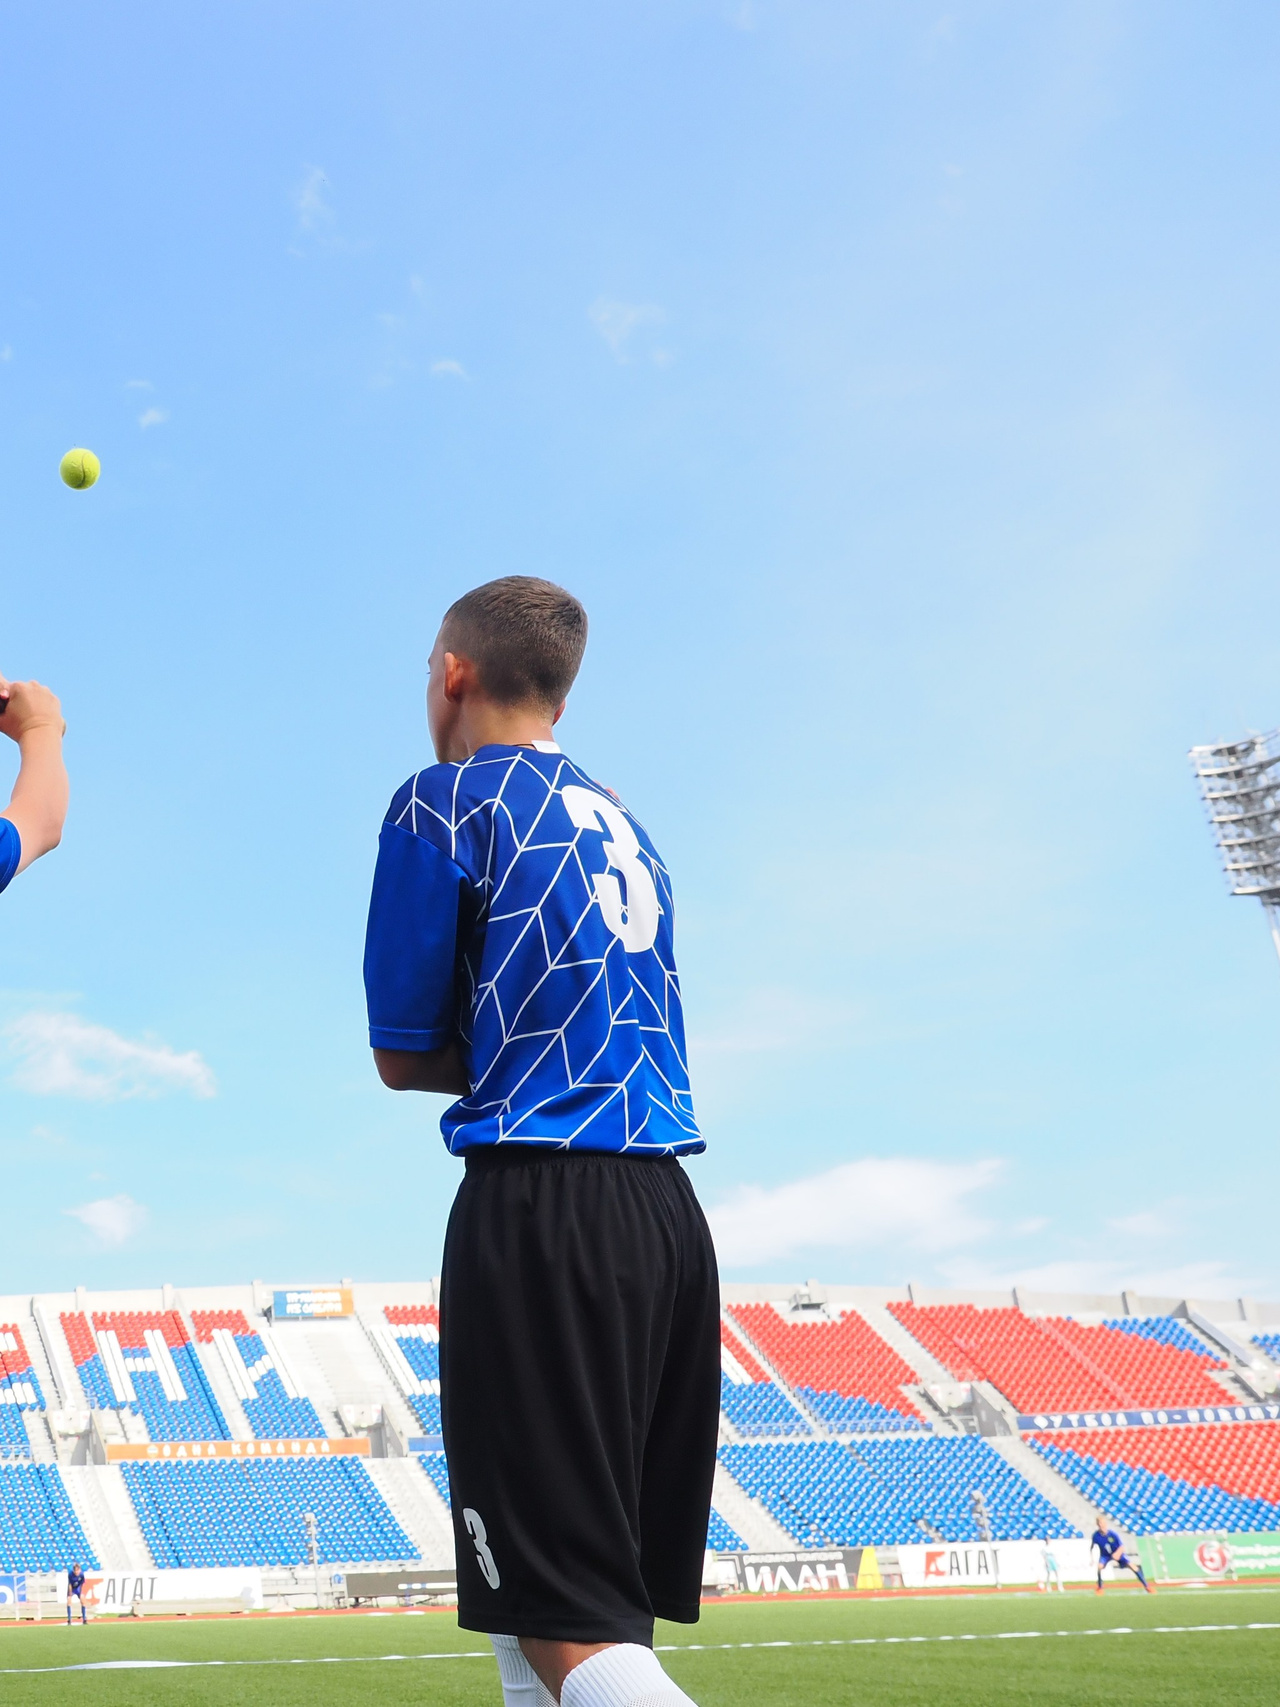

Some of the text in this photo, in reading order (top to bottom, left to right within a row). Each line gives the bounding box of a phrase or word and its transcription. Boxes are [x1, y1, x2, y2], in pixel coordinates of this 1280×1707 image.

[561, 785, 659, 952] 3
[162, 1440, 331, 1458] ОДНА КОМАНДА
[462, 1507, 501, 1590] 3
[949, 1549, 1000, 1576] АГАТ
[104, 1577, 158, 1604] АГАТ
